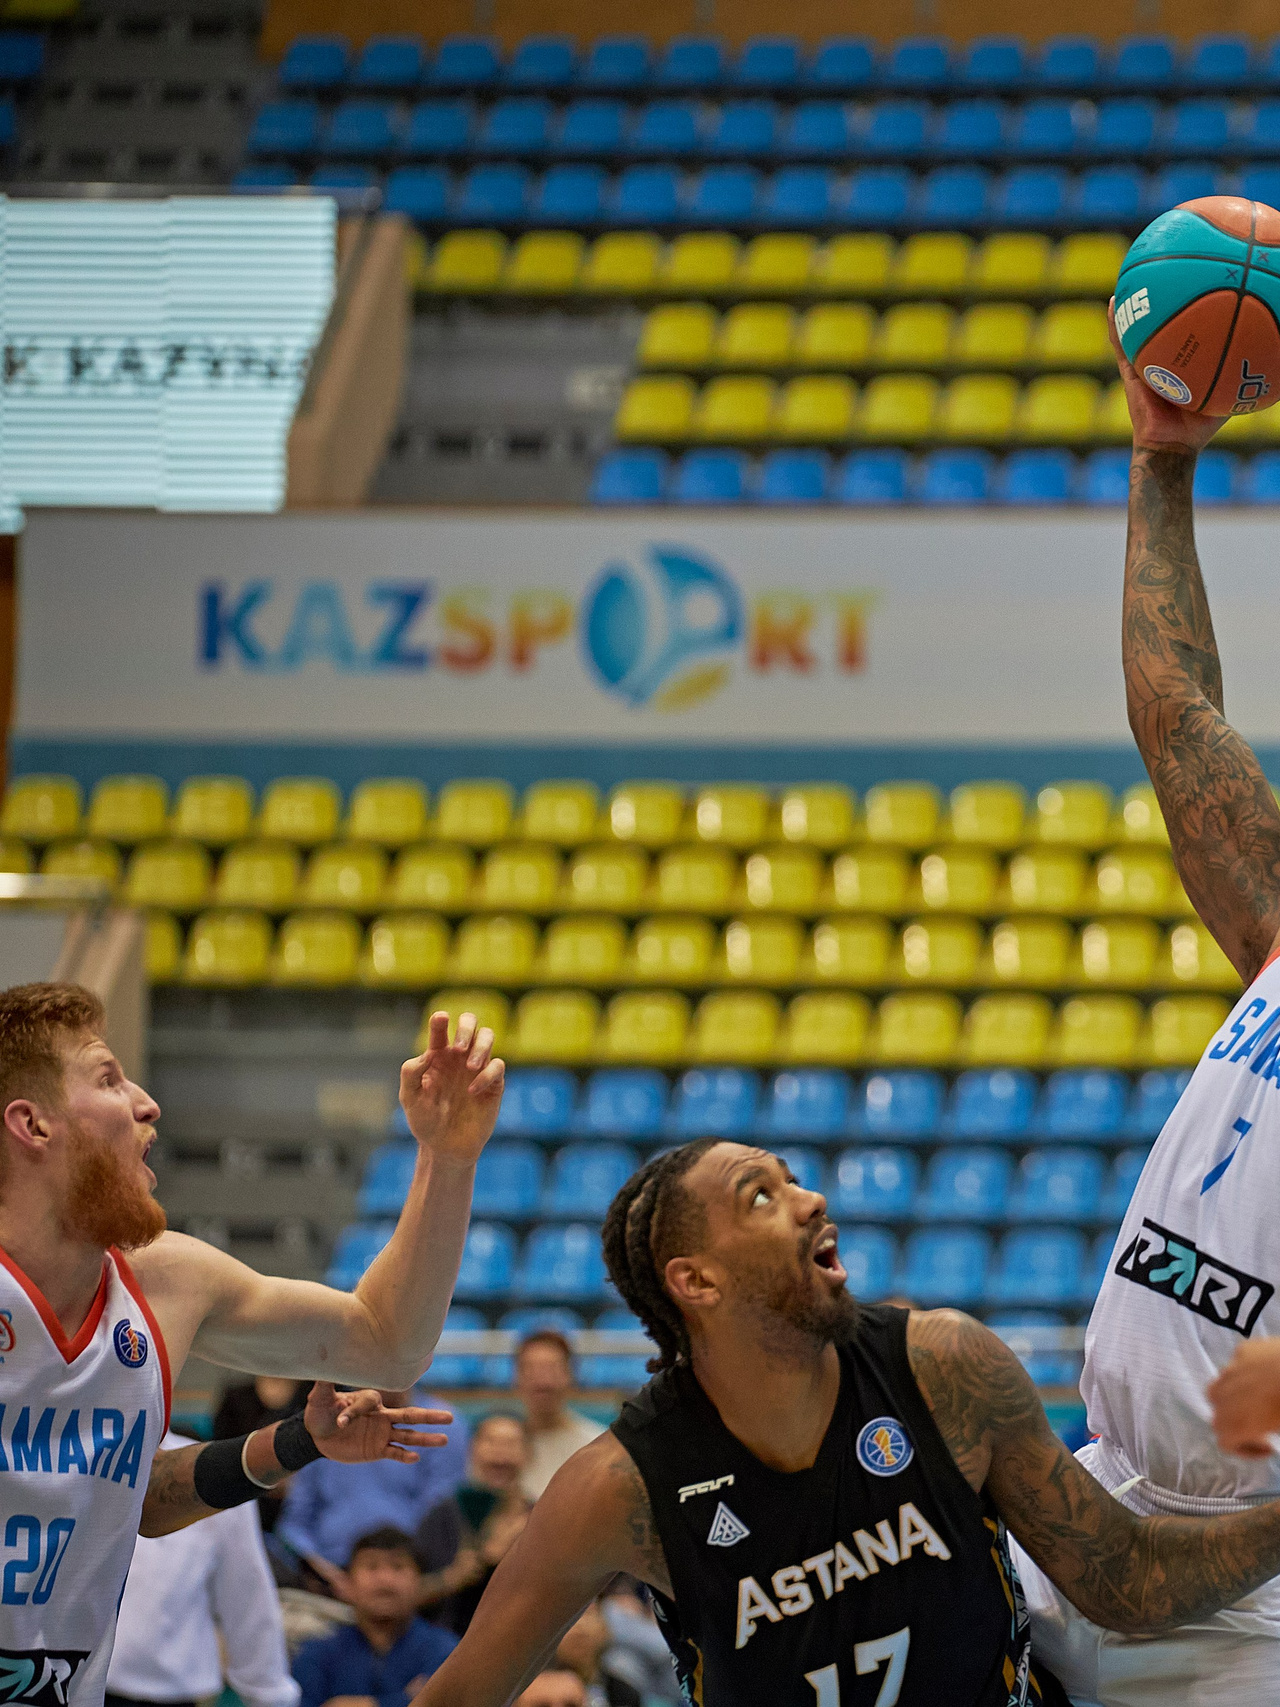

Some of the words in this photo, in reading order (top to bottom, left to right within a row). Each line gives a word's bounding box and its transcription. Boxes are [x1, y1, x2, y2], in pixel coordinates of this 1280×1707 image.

[1199, 1116, 1252, 1197] 7
[2, 1514, 76, 1606] 20
[735, 1502, 952, 1650] ASTANA
[804, 1626, 911, 1707] 17
